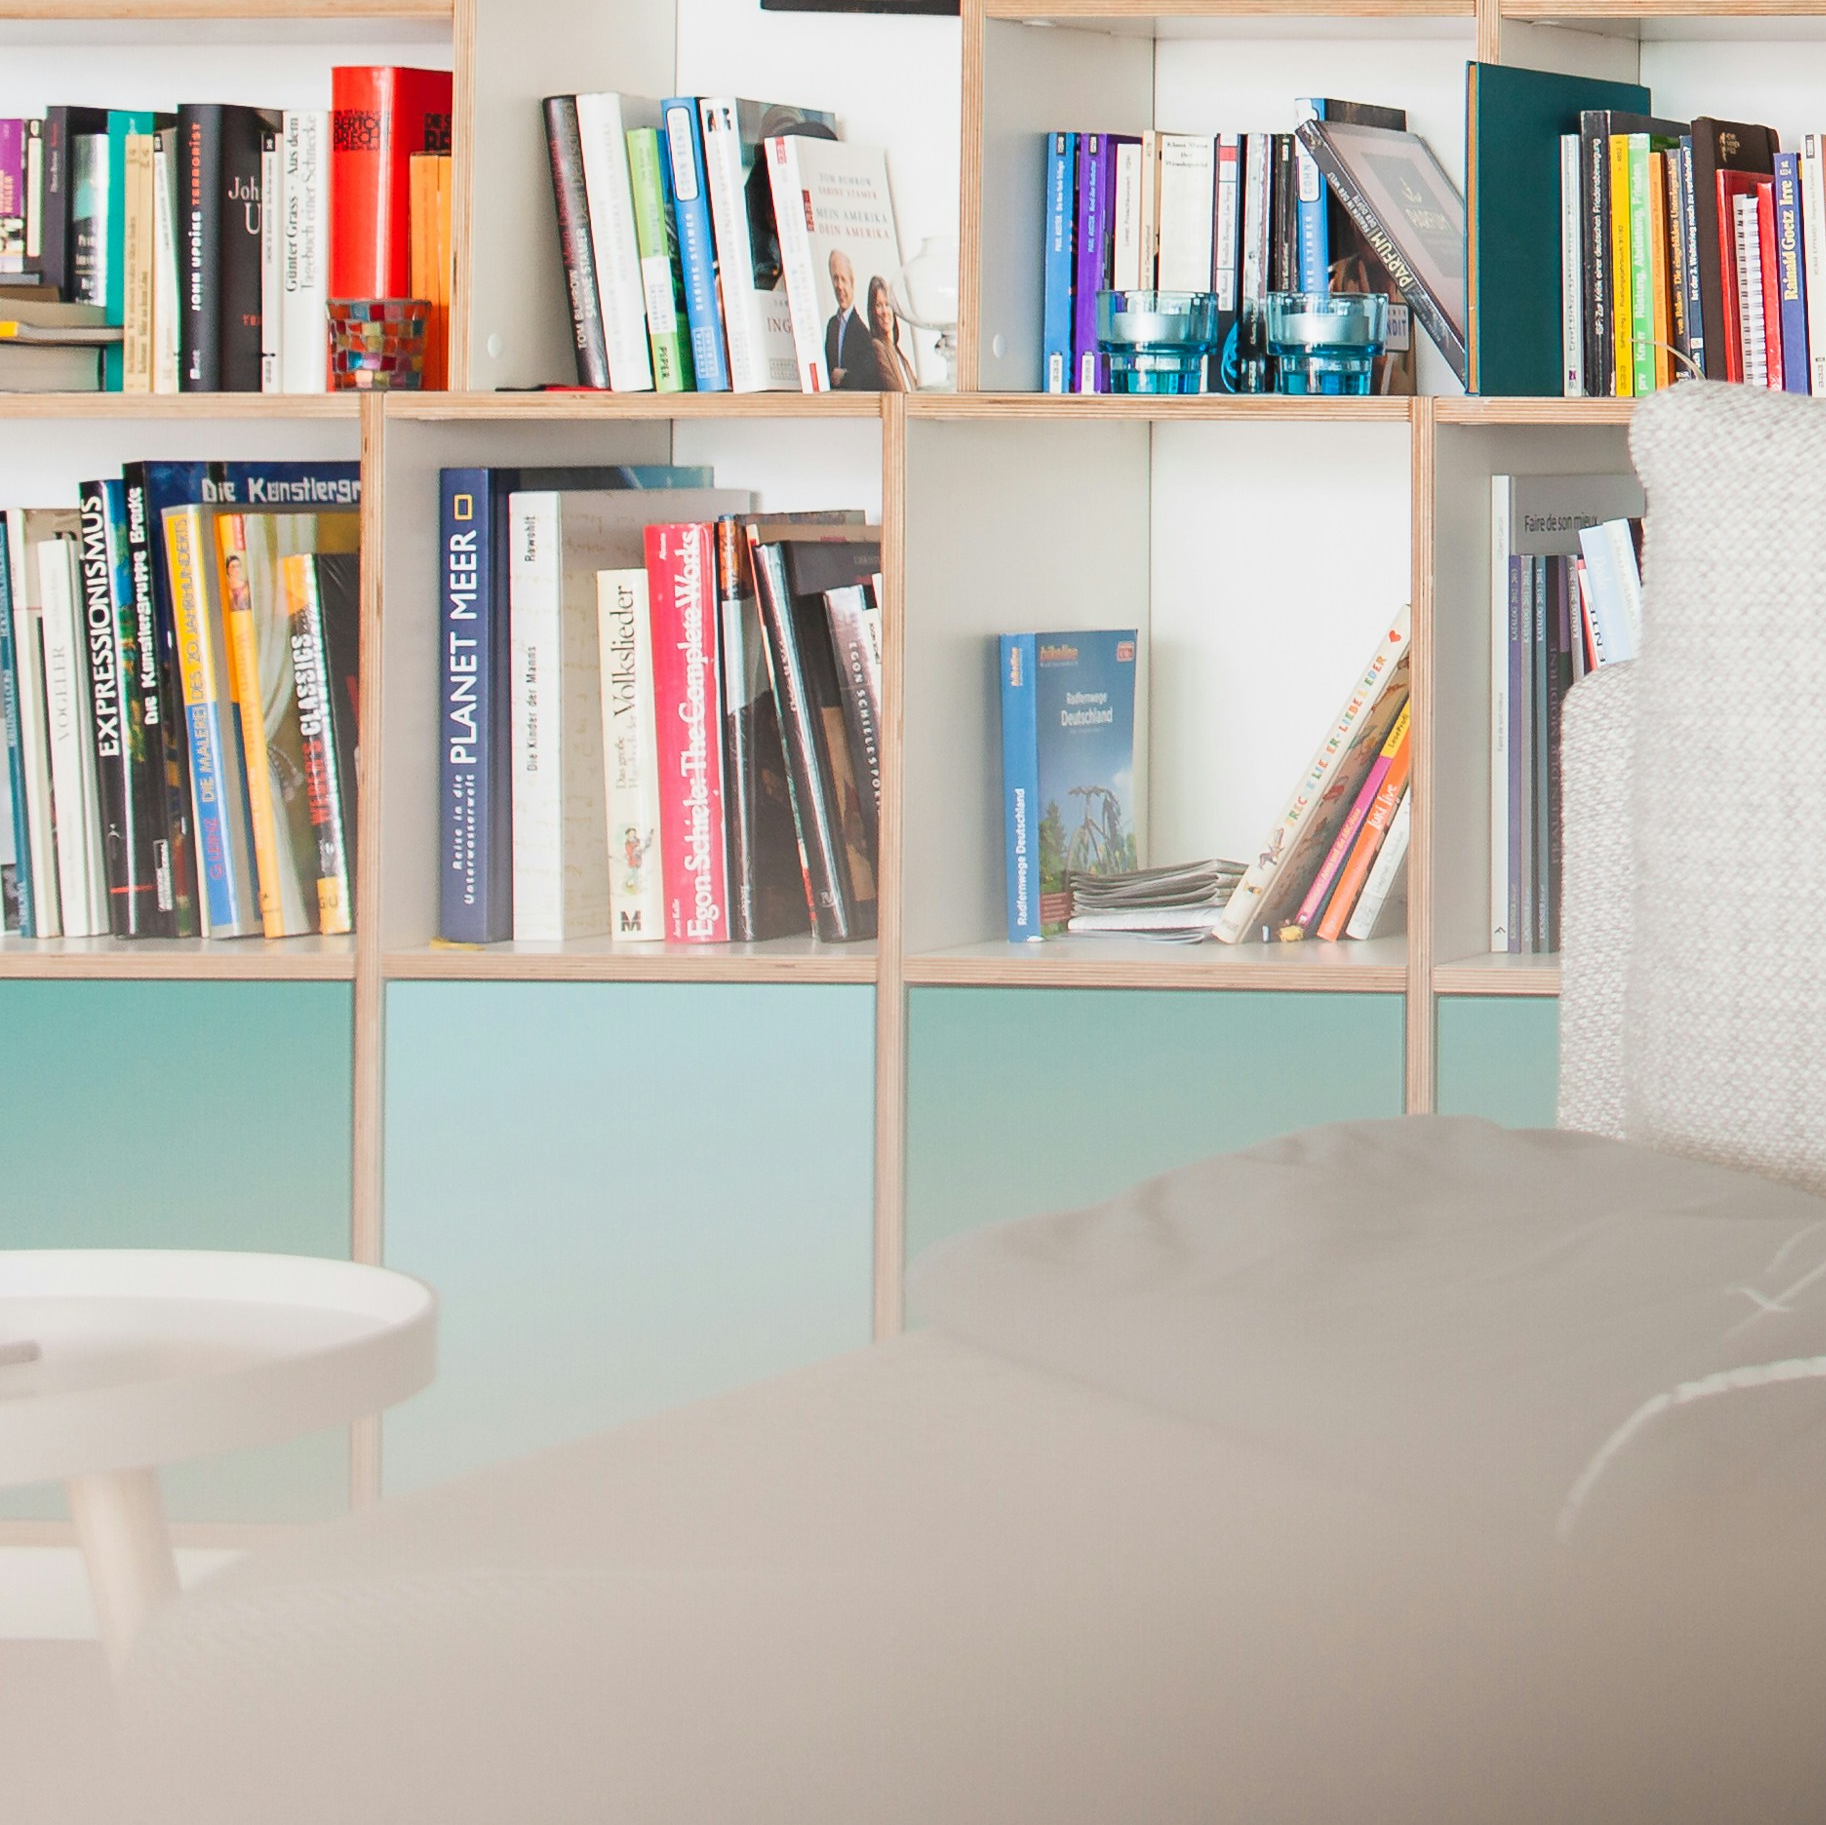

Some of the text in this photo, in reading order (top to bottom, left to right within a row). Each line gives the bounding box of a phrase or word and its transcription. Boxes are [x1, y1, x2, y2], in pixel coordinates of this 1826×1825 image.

[1369, 230, 1414, 286] PARFUM
[1778, 180, 1798, 300] Rainald Goetz Irre
[80, 497, 120, 756] EXPRESSIONISMUS
[448, 531, 479, 765] PLANET MEER
[612, 585, 637, 717] Volkslieder
[669, 531, 718, 937] Egon Schiele: The Complete Works
[1014, 788, 1028, 926] Radfernwege Deutschland
